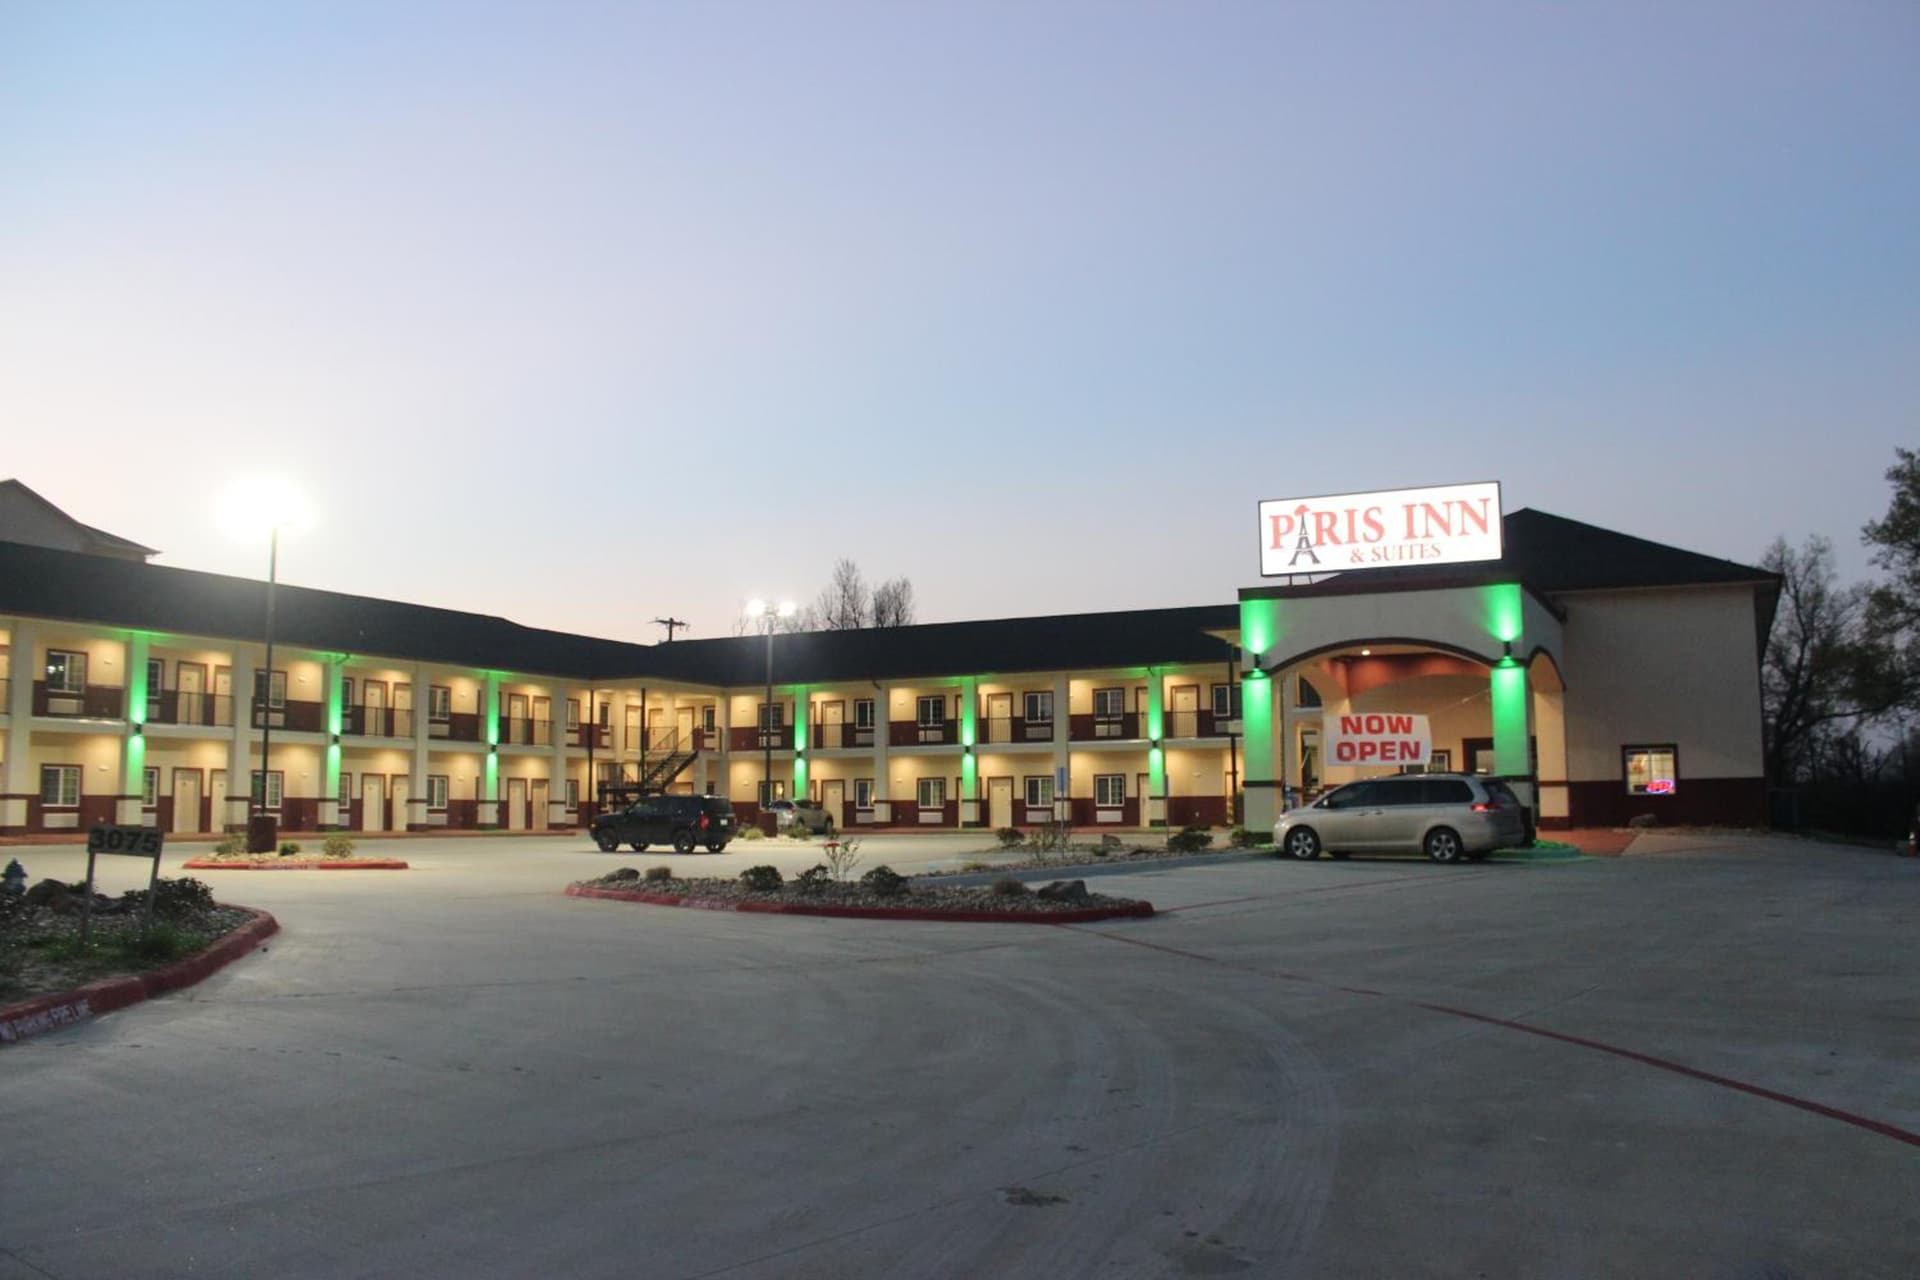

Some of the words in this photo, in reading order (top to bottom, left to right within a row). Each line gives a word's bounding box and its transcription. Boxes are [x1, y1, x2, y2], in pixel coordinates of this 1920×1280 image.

[1269, 505, 1385, 565] PARIS
[1402, 498, 1491, 540] INN
[1350, 548, 1364, 563] &
[1371, 543, 1441, 562] SUITES
[1340, 715, 1413, 735] NOW
[1336, 741, 1420, 762] OPEN
[91, 828, 158, 853] 3075
